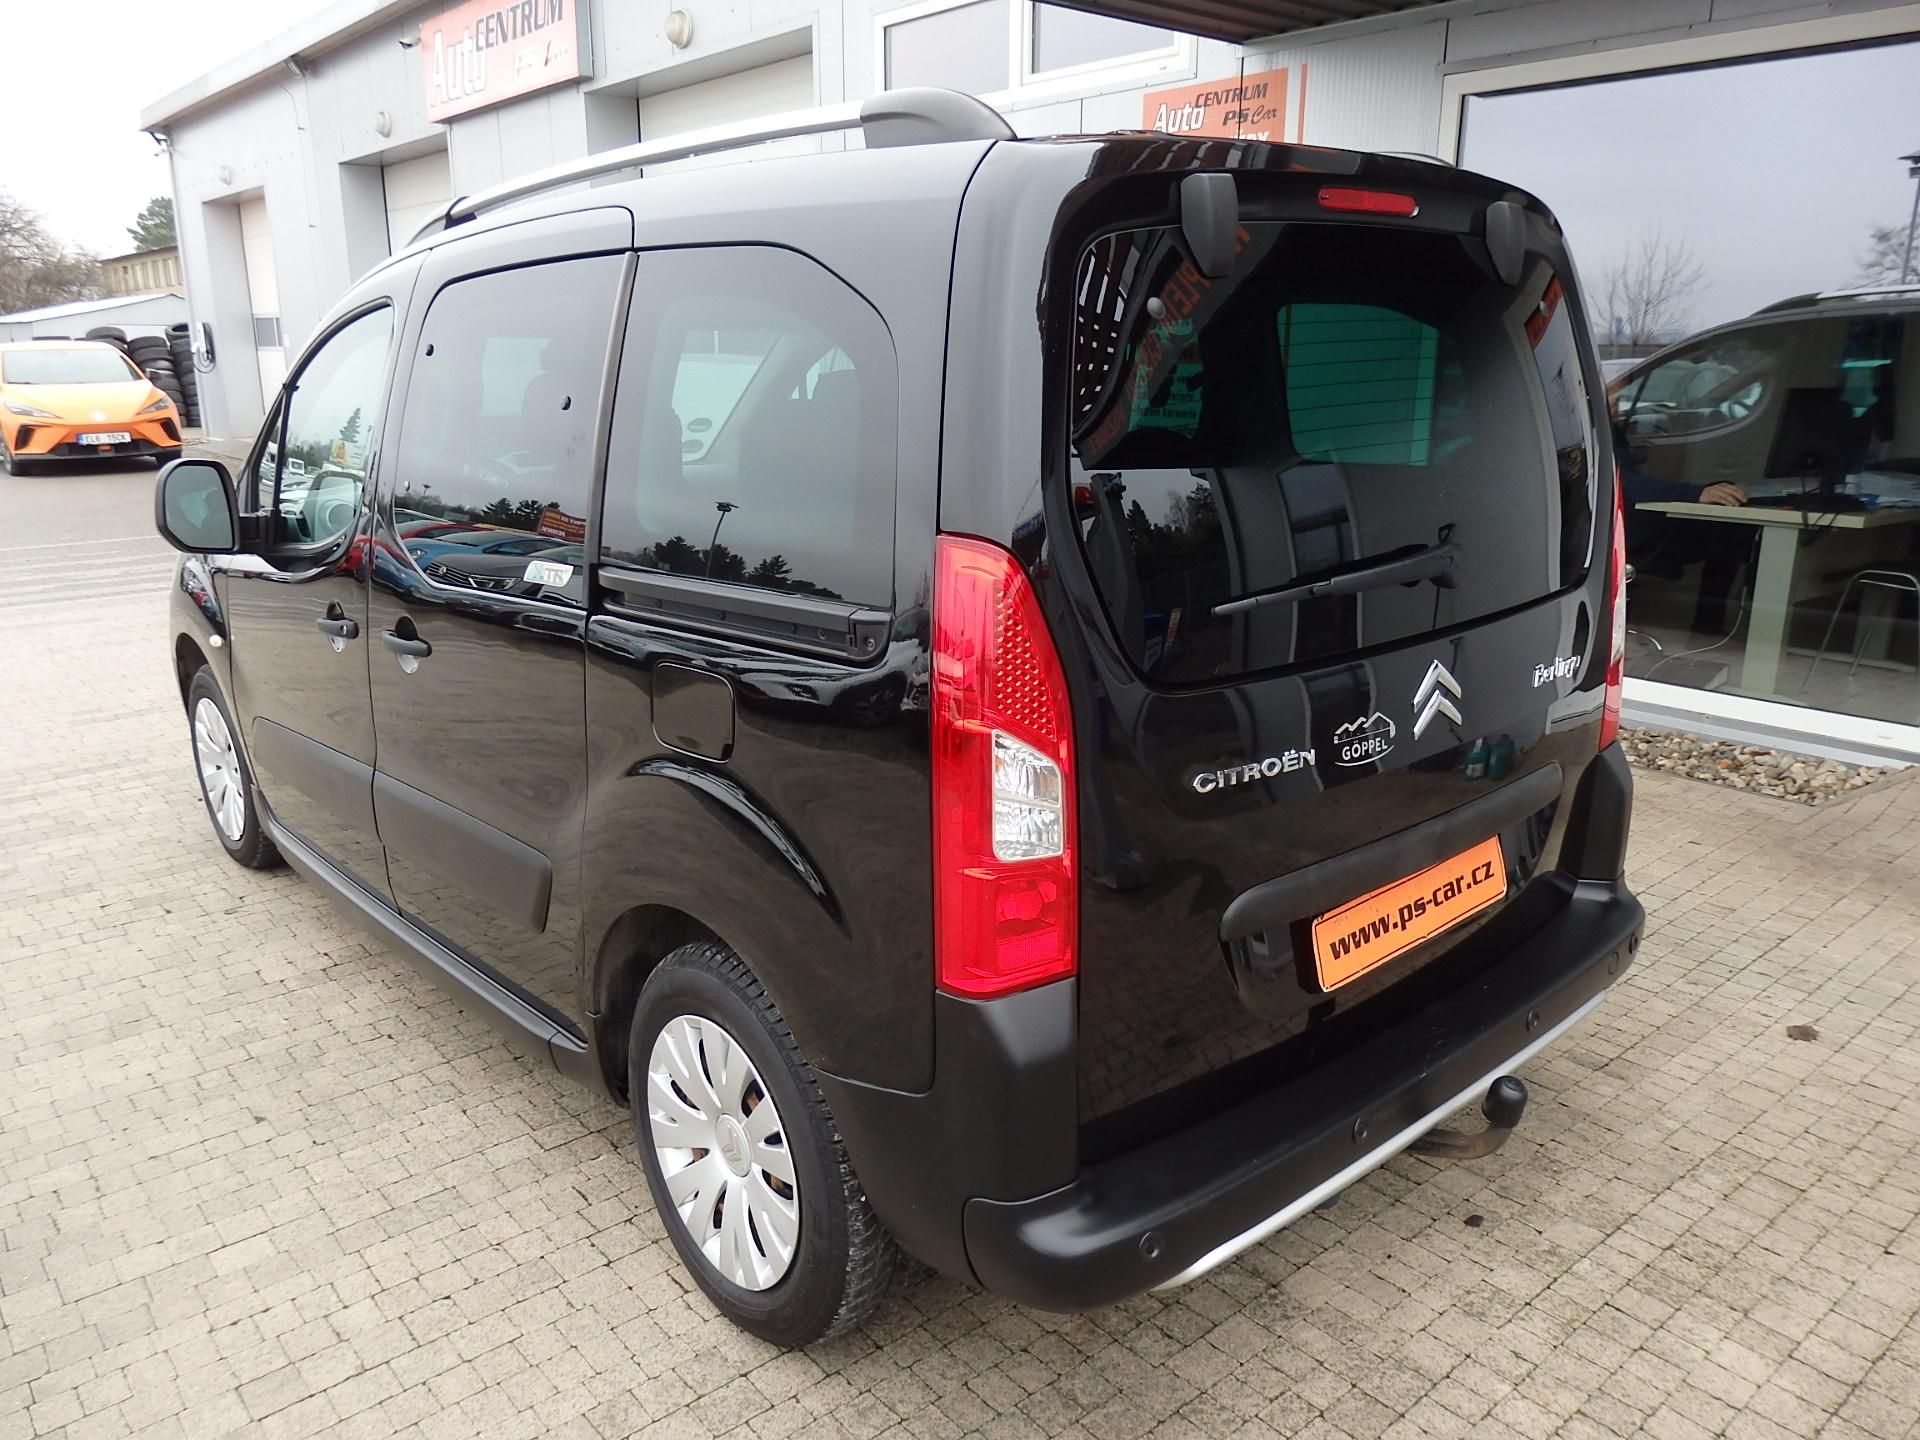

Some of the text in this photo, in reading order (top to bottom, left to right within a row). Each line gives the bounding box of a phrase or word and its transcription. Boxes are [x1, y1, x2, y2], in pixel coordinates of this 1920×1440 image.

[475, 0, 563, 52] CENTRUM
[1154, 83, 1268, 133] Auto CENTRUM
[1223, 105, 1278, 126] PS Car
[1192, 748, 1316, 793] CITROËN
[1342, 737, 1388, 761] GÖPPEL
[1329, 861, 1495, 960] www.ps-car.cz
